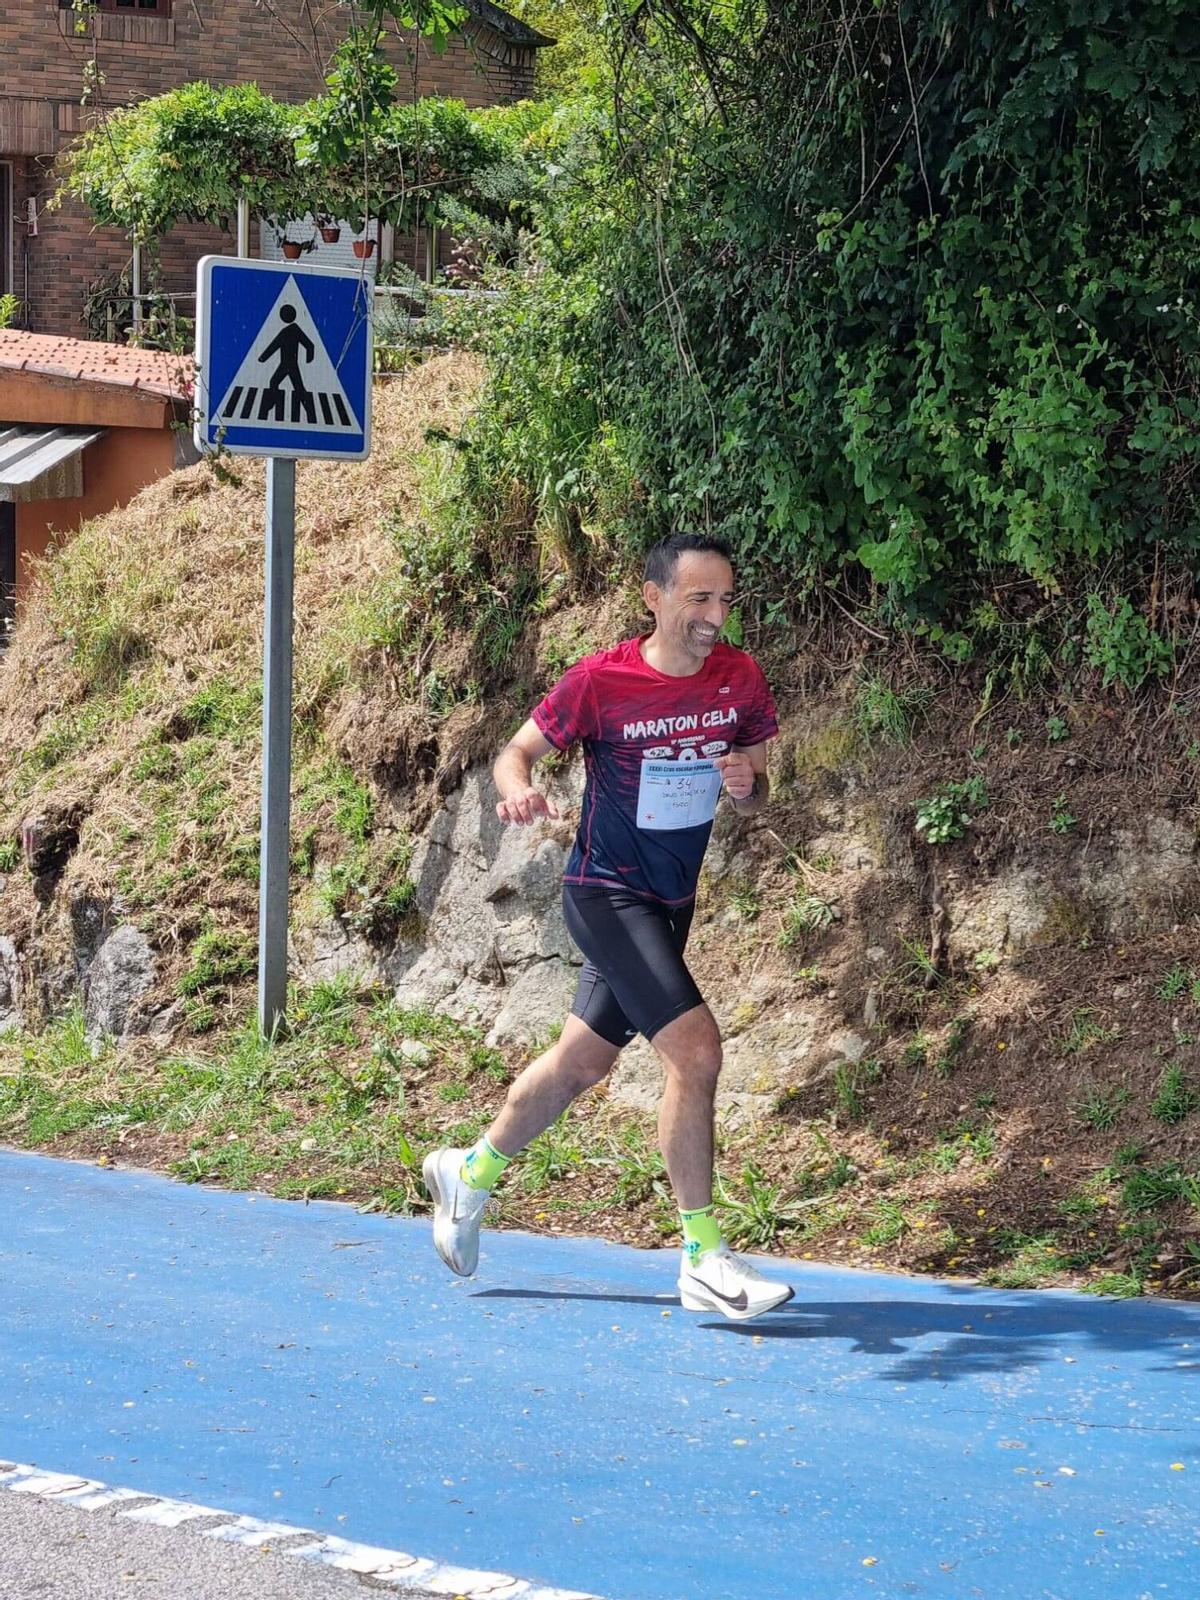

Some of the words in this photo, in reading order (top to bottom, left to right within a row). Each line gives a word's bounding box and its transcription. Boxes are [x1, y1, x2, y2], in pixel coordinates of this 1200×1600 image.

[623, 714, 698, 740] MARATON
[702, 707, 738, 727] CELA
[649, 749, 667, 757] 42K
[707, 744, 724, 752] 2024
[676, 778, 692, 790] 34
